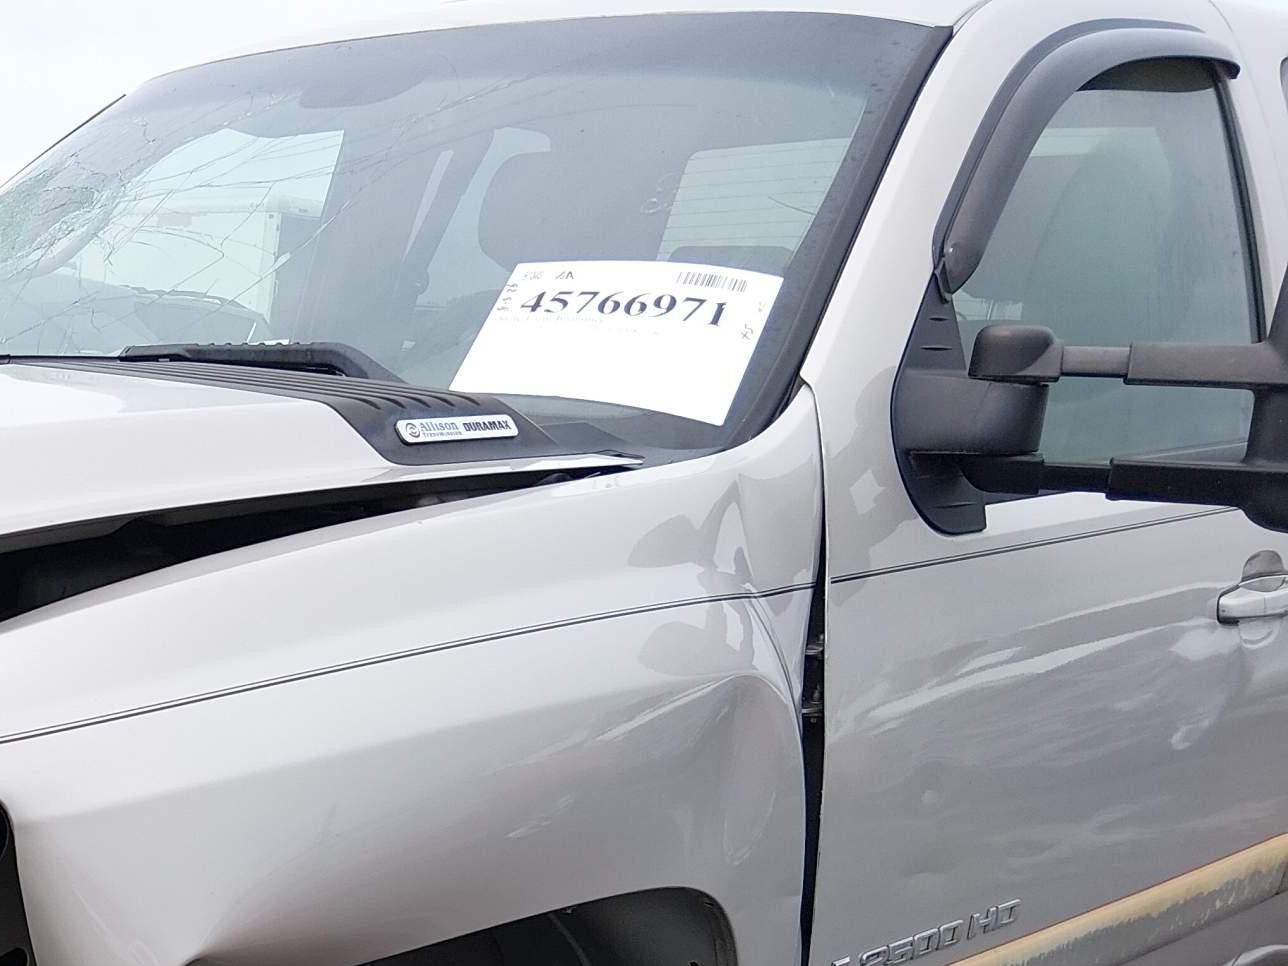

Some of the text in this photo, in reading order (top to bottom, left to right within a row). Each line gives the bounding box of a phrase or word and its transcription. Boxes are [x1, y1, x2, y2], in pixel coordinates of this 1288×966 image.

[520, 290, 728, 326] 45766971
[419, 420, 512, 433] Allison DURAMAX
[967, 899, 1021, 940] HD
